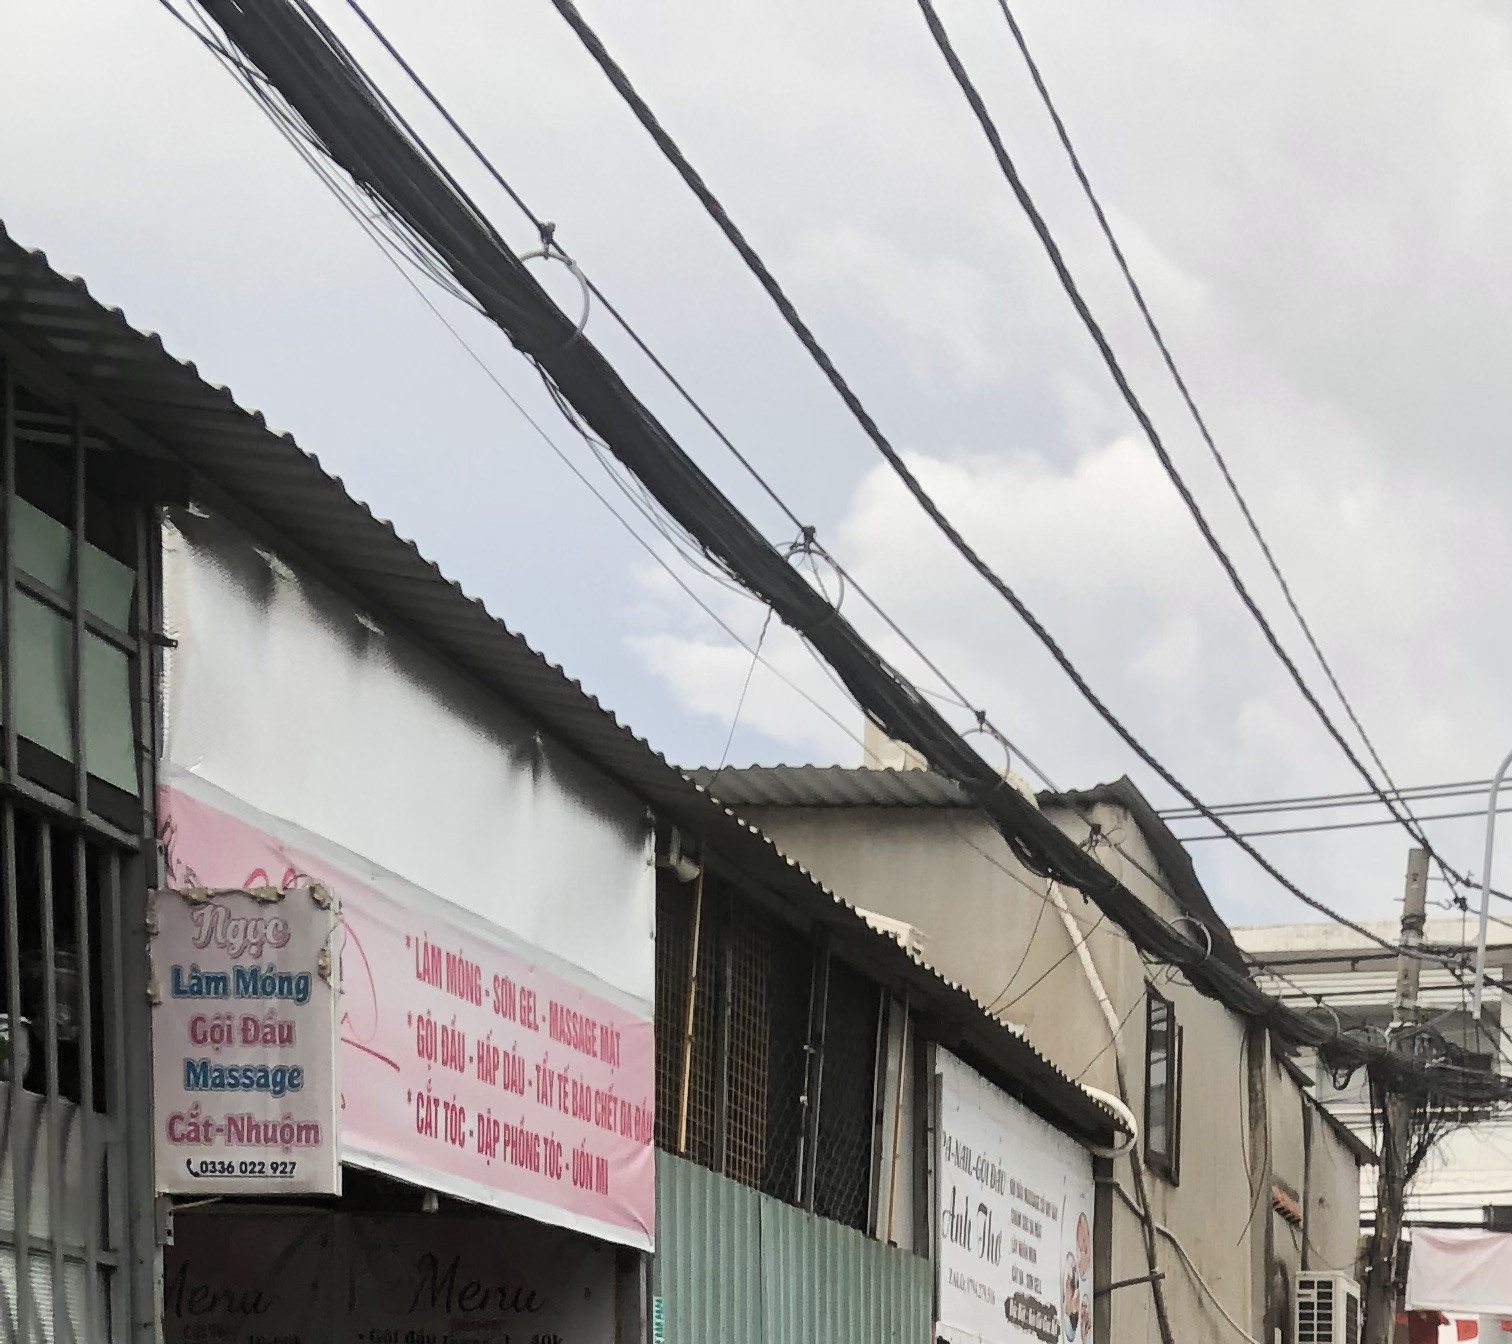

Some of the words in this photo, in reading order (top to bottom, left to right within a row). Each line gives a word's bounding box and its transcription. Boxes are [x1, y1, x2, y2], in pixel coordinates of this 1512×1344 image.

[171, 963, 231, 1000] Làm
[233, 964, 312, 1006] Móng
[415, 931, 442, 989] LÀM
[446, 949, 482, 1006] MÓNG
[520, 986, 539, 1032] GEL
[550, 1000, 597, 1058] MASSAGE
[189, 1013, 236, 1053] Gội
[417, 1009, 437, 1071] GỘI
[183, 1057, 304, 1098] Massage
[166, 1101, 322, 1153] Cắt-Nhuộm
[417, 1079, 440, 1139] CẮT
[443, 1095, 466, 1149] TÓC
[543, 1131, 562, 1181] TÓC
[200, 1161, 235, 1175] 0336
[240, 1161, 266, 1175] 022
[271, 1161, 297, 1175] 927
[408, 1251, 546, 1315] Menu
